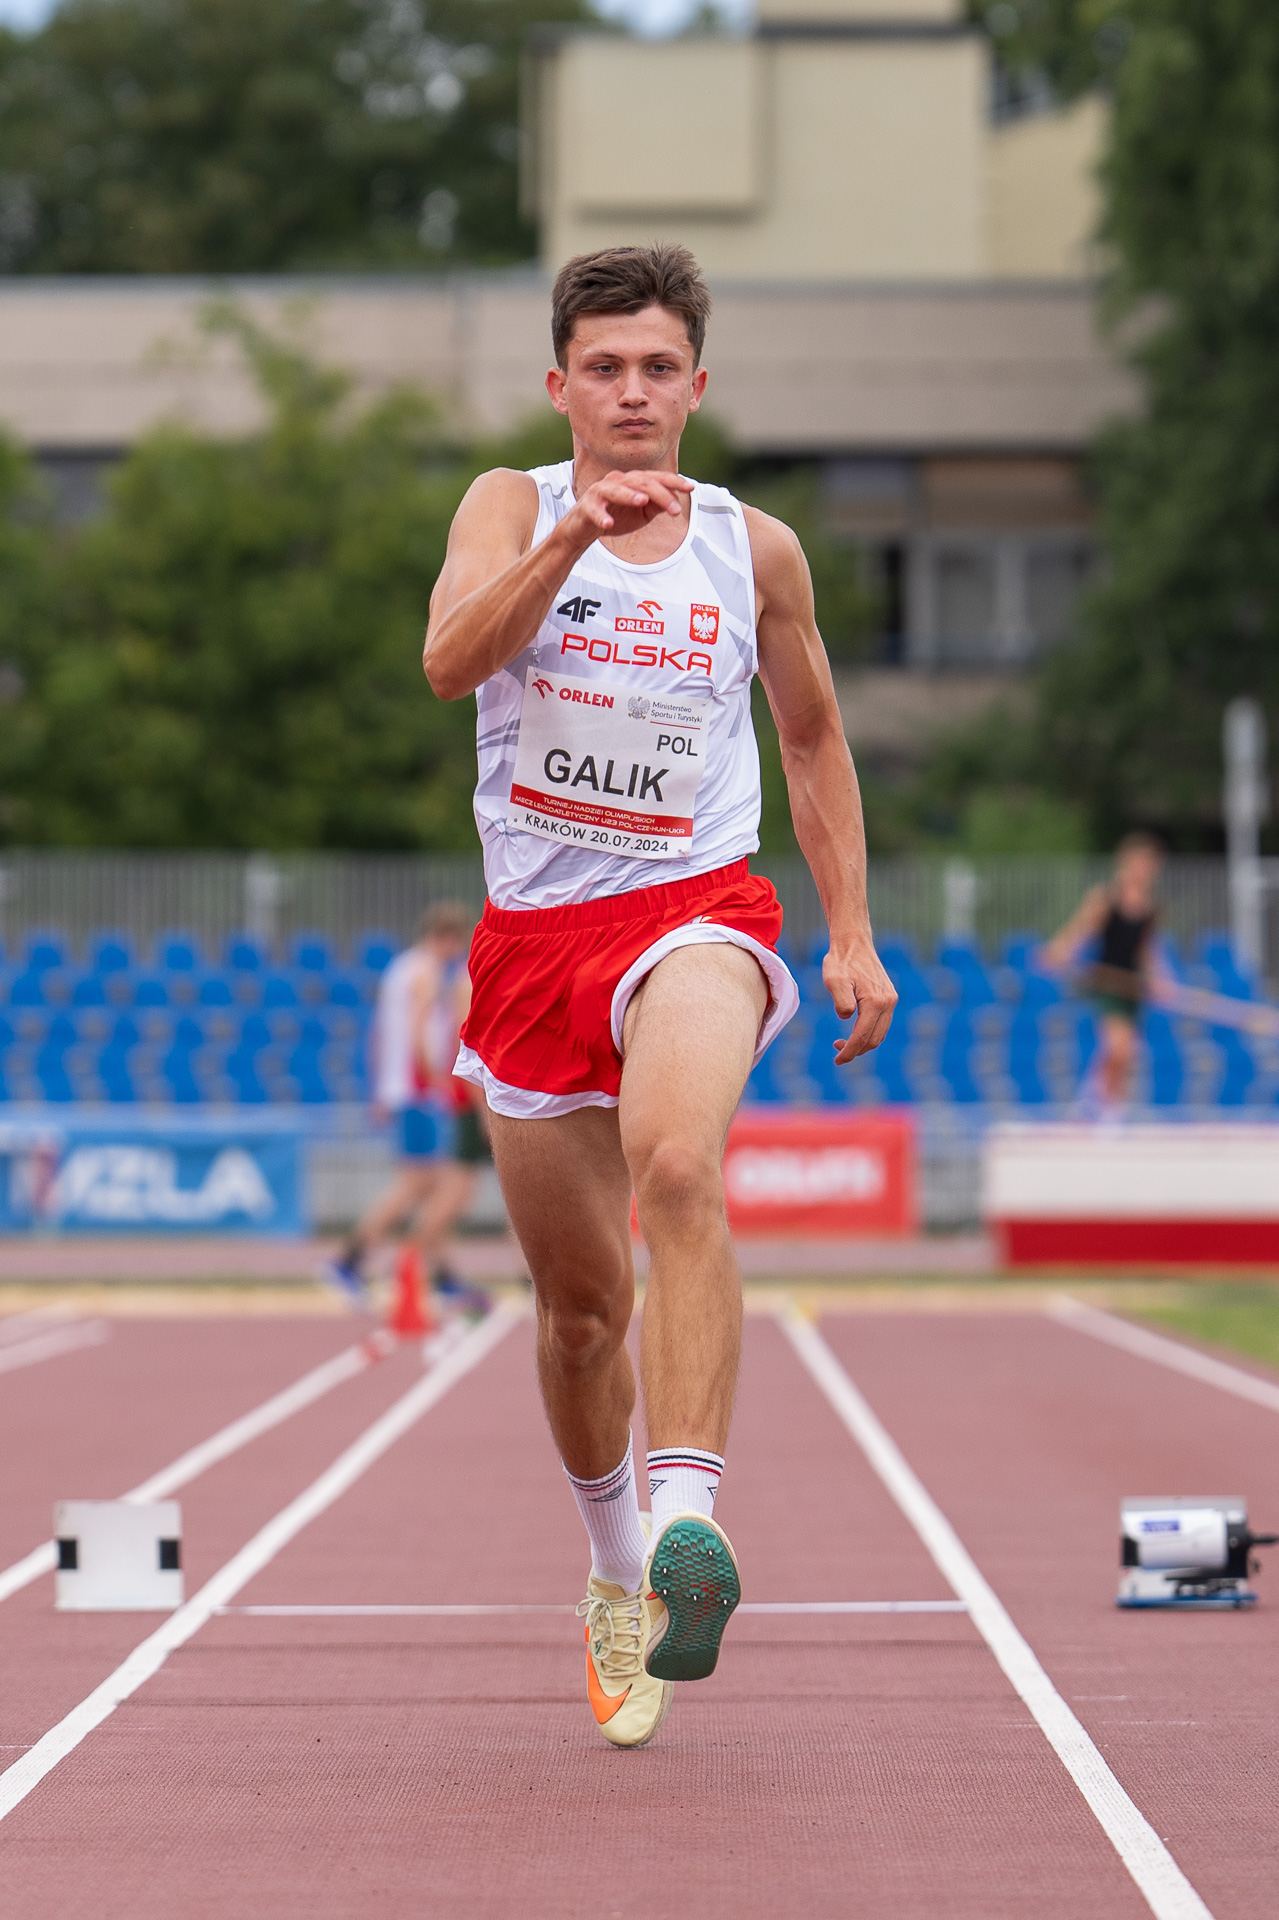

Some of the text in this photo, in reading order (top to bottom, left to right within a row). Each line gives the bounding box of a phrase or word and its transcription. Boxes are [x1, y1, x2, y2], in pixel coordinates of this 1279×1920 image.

[557, 596, 602, 624] 4F
[692, 604, 718, 613] POLSKA
[617, 619, 662, 634] ORLEN
[560, 633, 713, 676] POLSKA
[558, 687, 615, 709] ORLEN
[652, 701, 692, 713] Ministerstwo
[651, 709, 673, 719] Sportu
[677, 713, 703, 723] Turystyki
[656, 734, 699, 757] POL
[543, 748, 671, 803] GALIK
[514, 795, 534, 807] MECZ
[533, 802, 600, 822] LEKKOATLETYCZNY
[601, 816, 618, 826] U23
[543, 796, 656, 824] TURNIEJ NADZIEI OLIMPIJSKICH
[525, 813, 669, 852] KRAKÓW 20.07.2024
